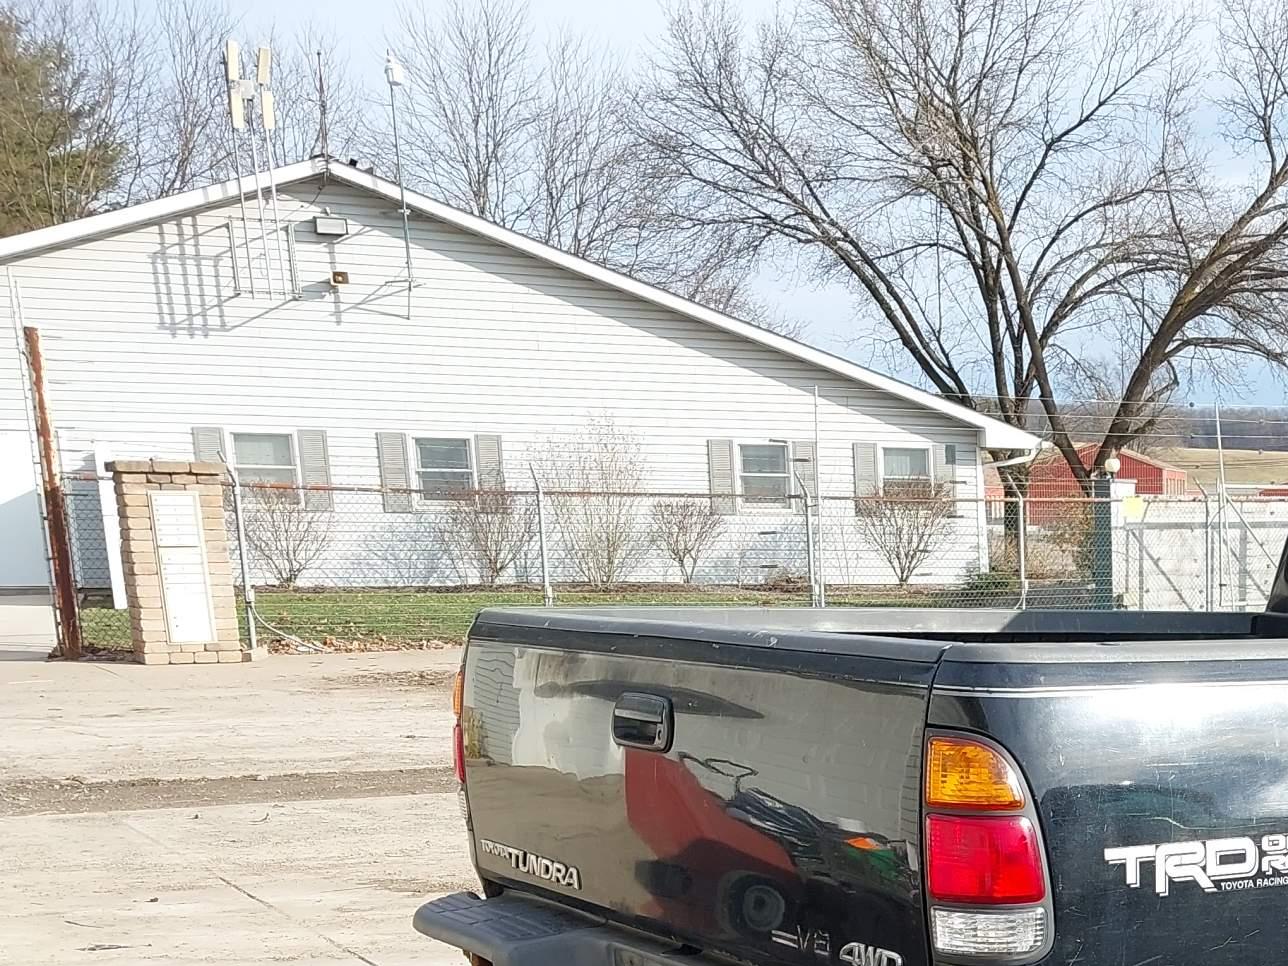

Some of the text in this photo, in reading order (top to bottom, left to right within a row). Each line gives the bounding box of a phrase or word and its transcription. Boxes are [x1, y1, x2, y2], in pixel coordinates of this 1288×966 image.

[480, 838, 582, 890] TOYOTA TUNDRA
[1103, 836, 1260, 897] TRD
[1220, 879, 1255, 891] TOYOTA
